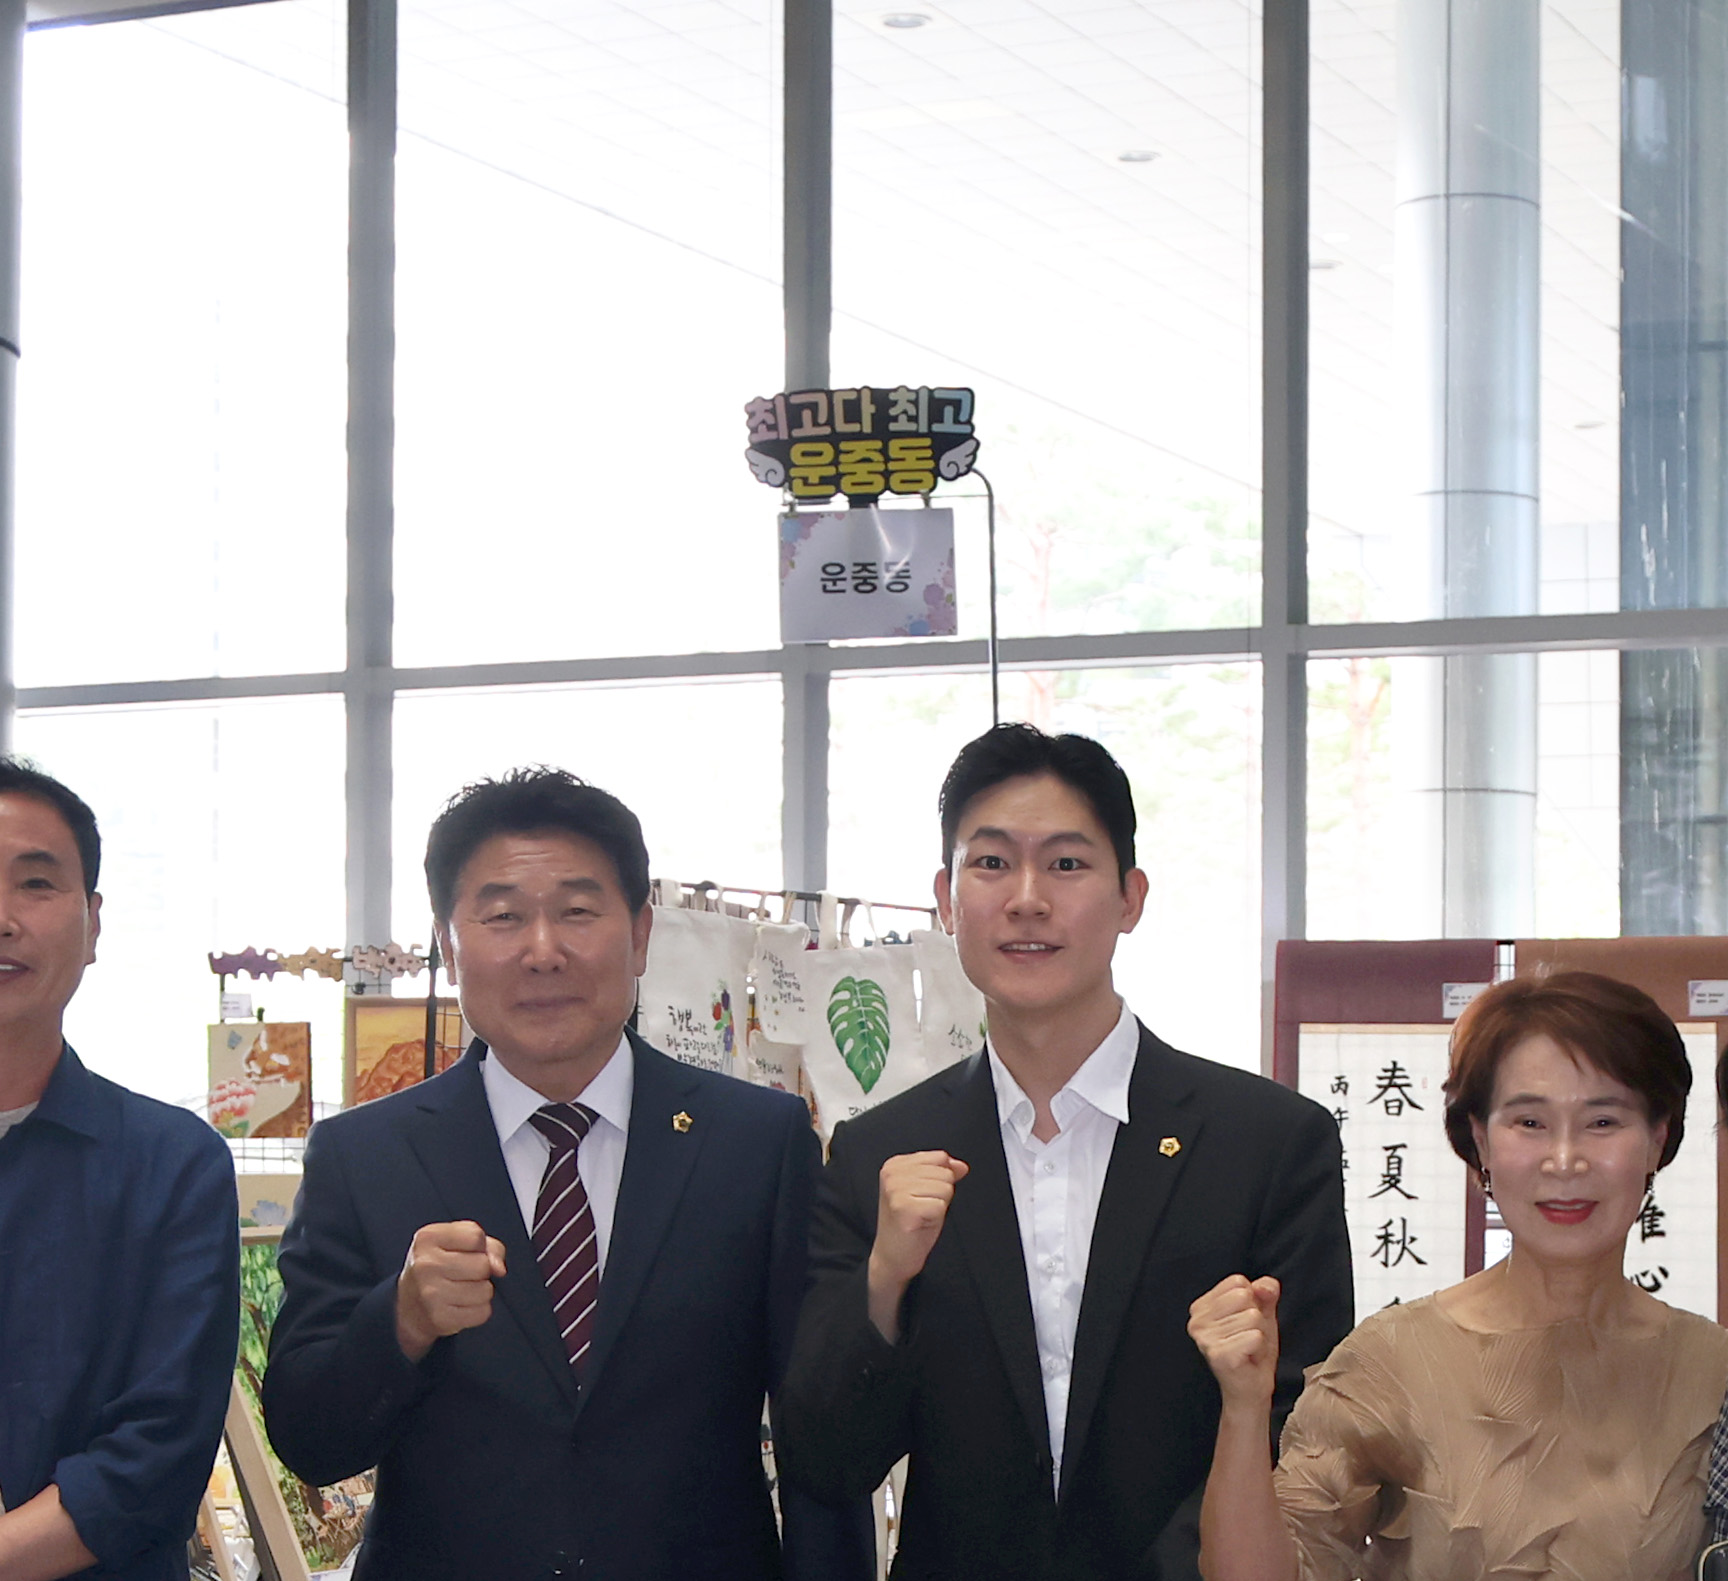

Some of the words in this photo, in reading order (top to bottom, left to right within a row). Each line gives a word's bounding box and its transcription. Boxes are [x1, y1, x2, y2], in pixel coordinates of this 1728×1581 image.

[745, 387, 876, 442] 최고다
[888, 386, 973, 434] 최고
[789, 437, 938, 497] 운중동
[820, 561, 912, 594] 운중동
[1367, 1060, 1428, 1309] 春夏秋
